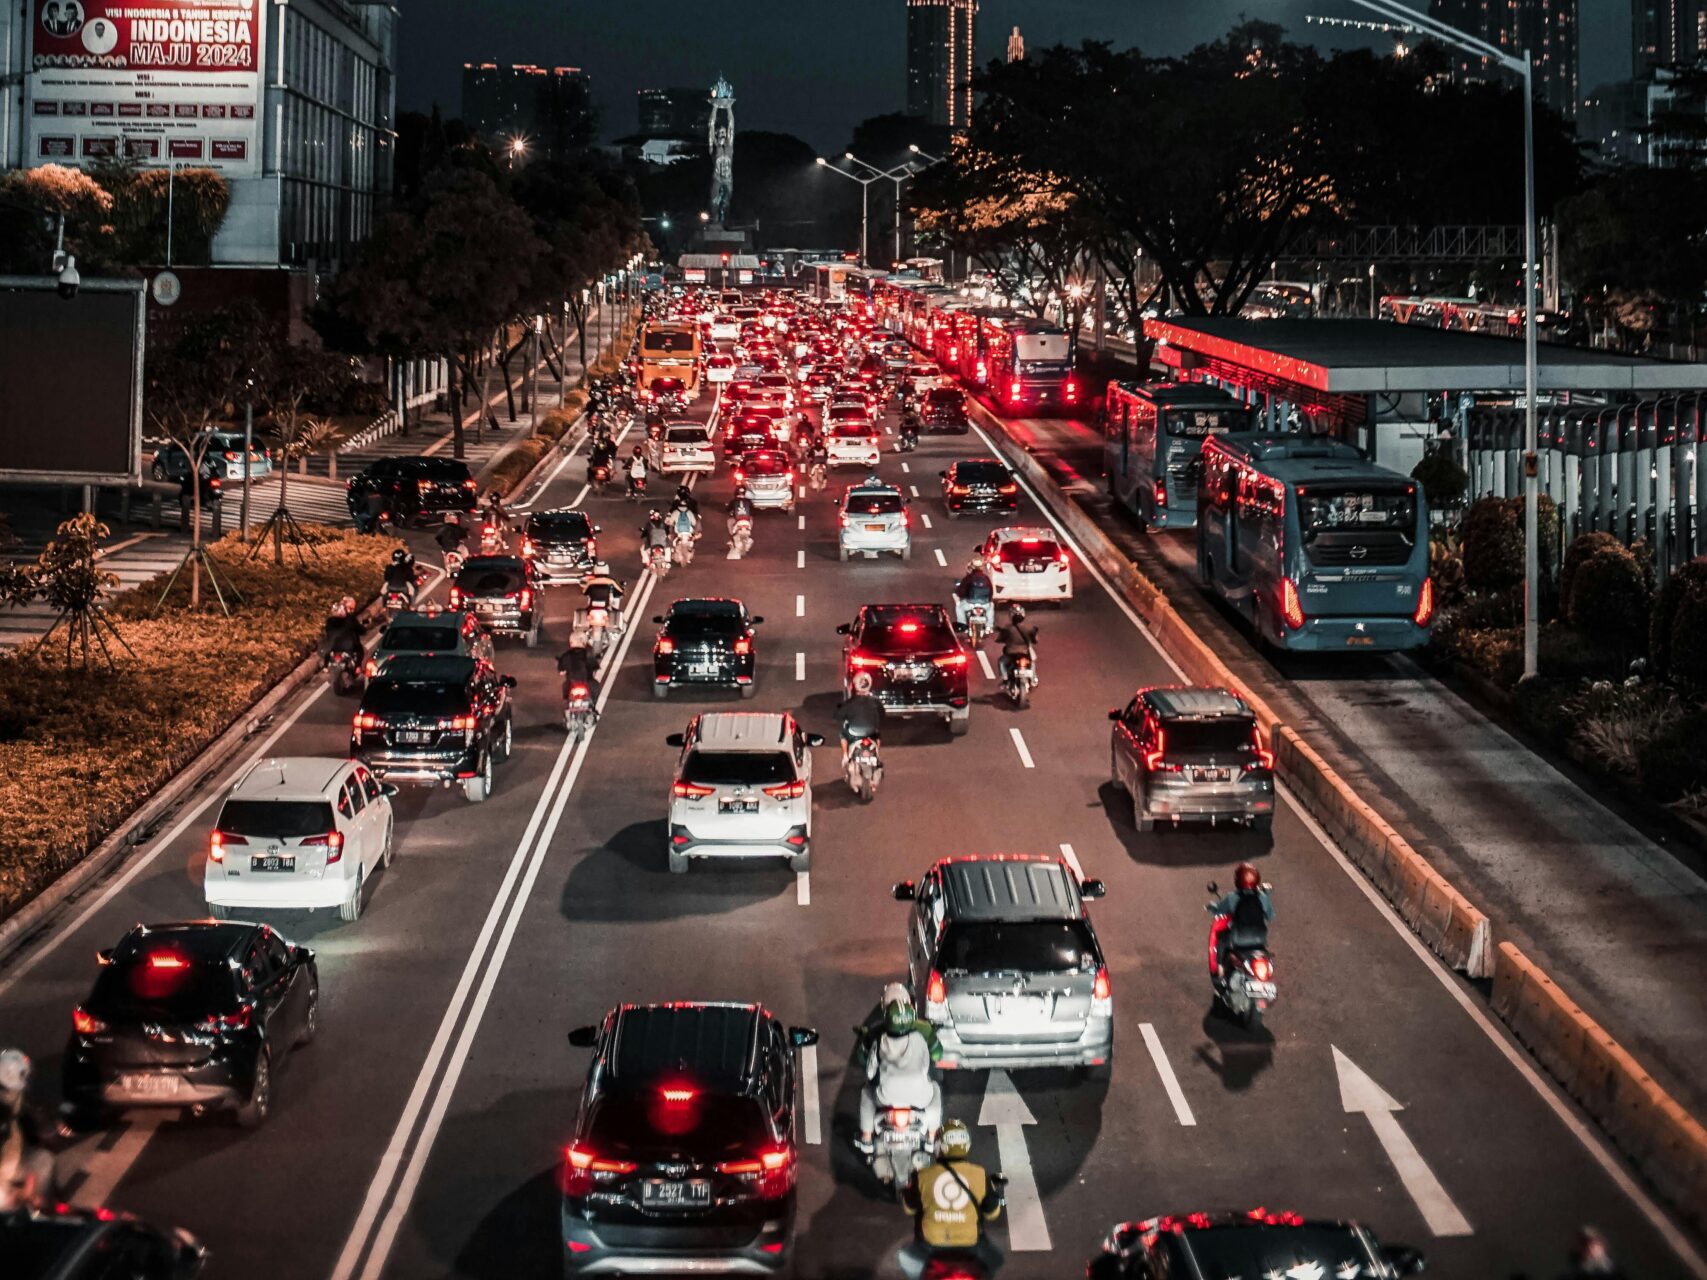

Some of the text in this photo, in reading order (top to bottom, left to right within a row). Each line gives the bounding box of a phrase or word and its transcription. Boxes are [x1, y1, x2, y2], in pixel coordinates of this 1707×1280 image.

[124, 8, 171, 20] INDONESIA
[130, 20, 252, 44] INDONESIA
[130, 42, 252, 67] MAJU 2024
[659, 1182, 684, 1198] 2527
